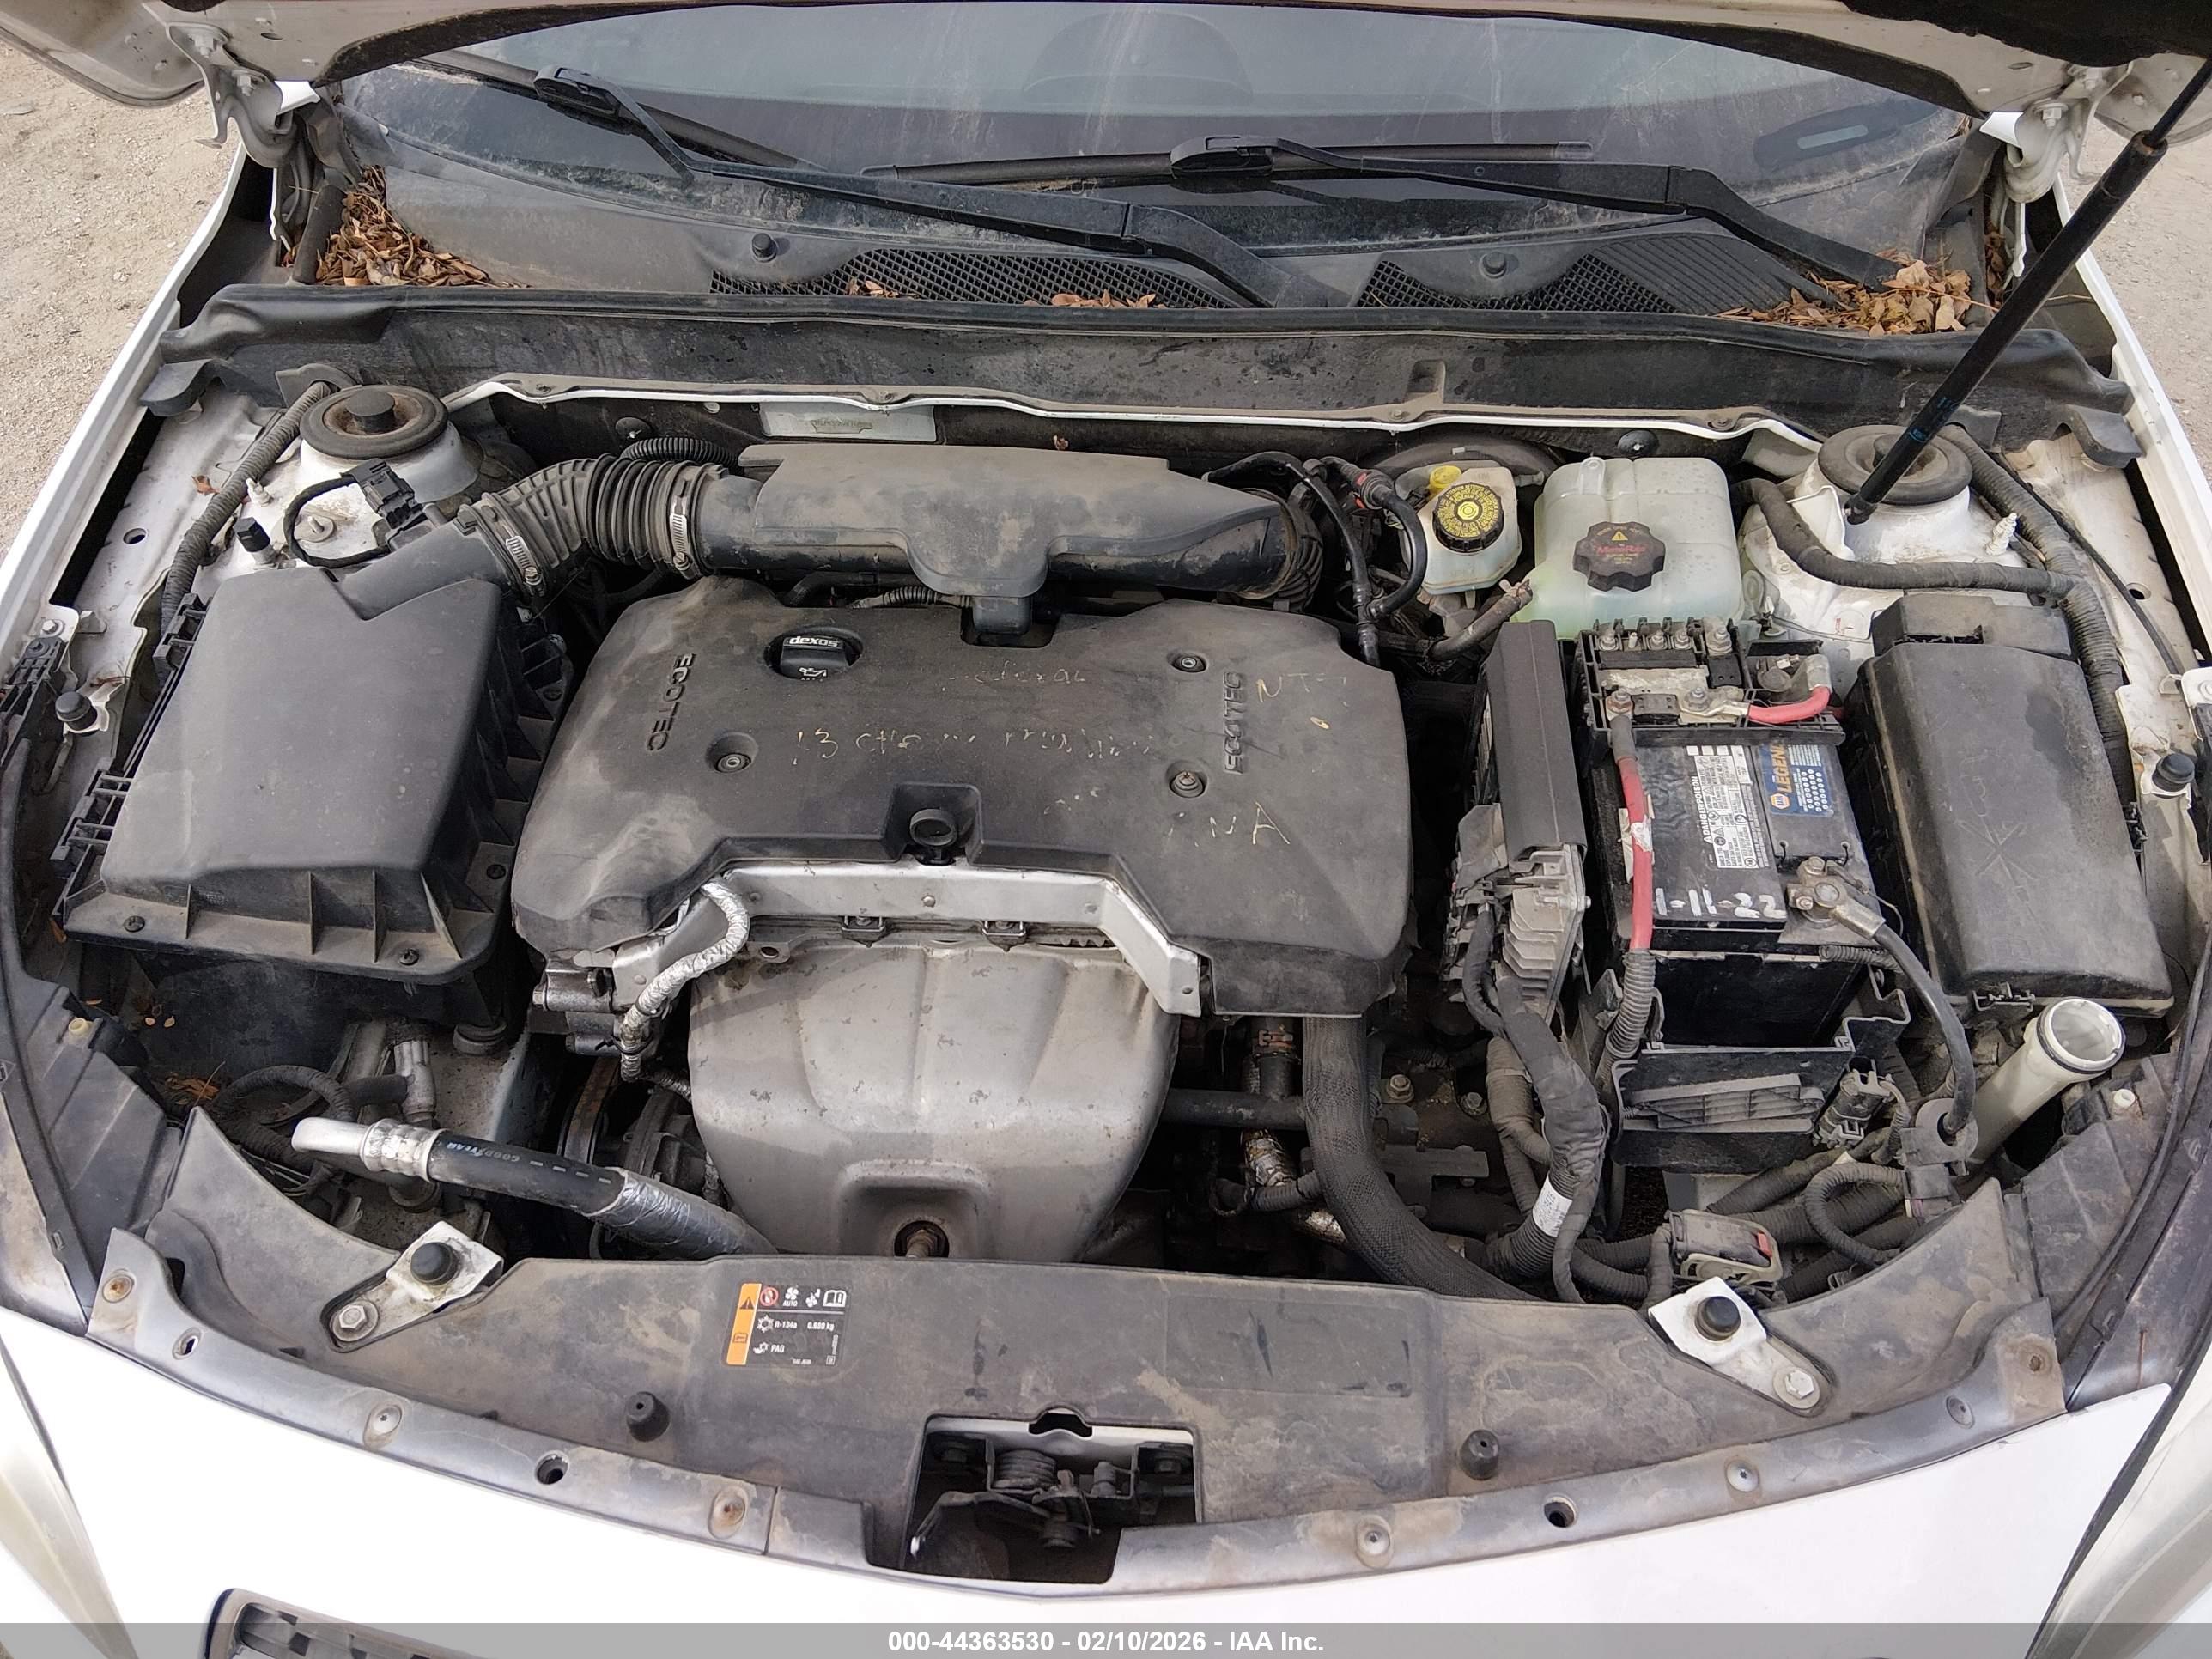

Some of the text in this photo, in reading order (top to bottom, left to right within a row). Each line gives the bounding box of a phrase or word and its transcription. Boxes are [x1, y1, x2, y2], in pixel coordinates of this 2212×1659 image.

[789, 635, 839, 647] dexos
[646, 653, 696, 751] ECOTEC
[1223, 672, 1245, 775] ECOTEC
[1691, 775, 1712, 836] DANGER/POISON
[447, 1142, 520, 1162] GOODYEAR
[775, 1320, 798, 1329] R-134a
[826, 1322, 835, 1332] kg
